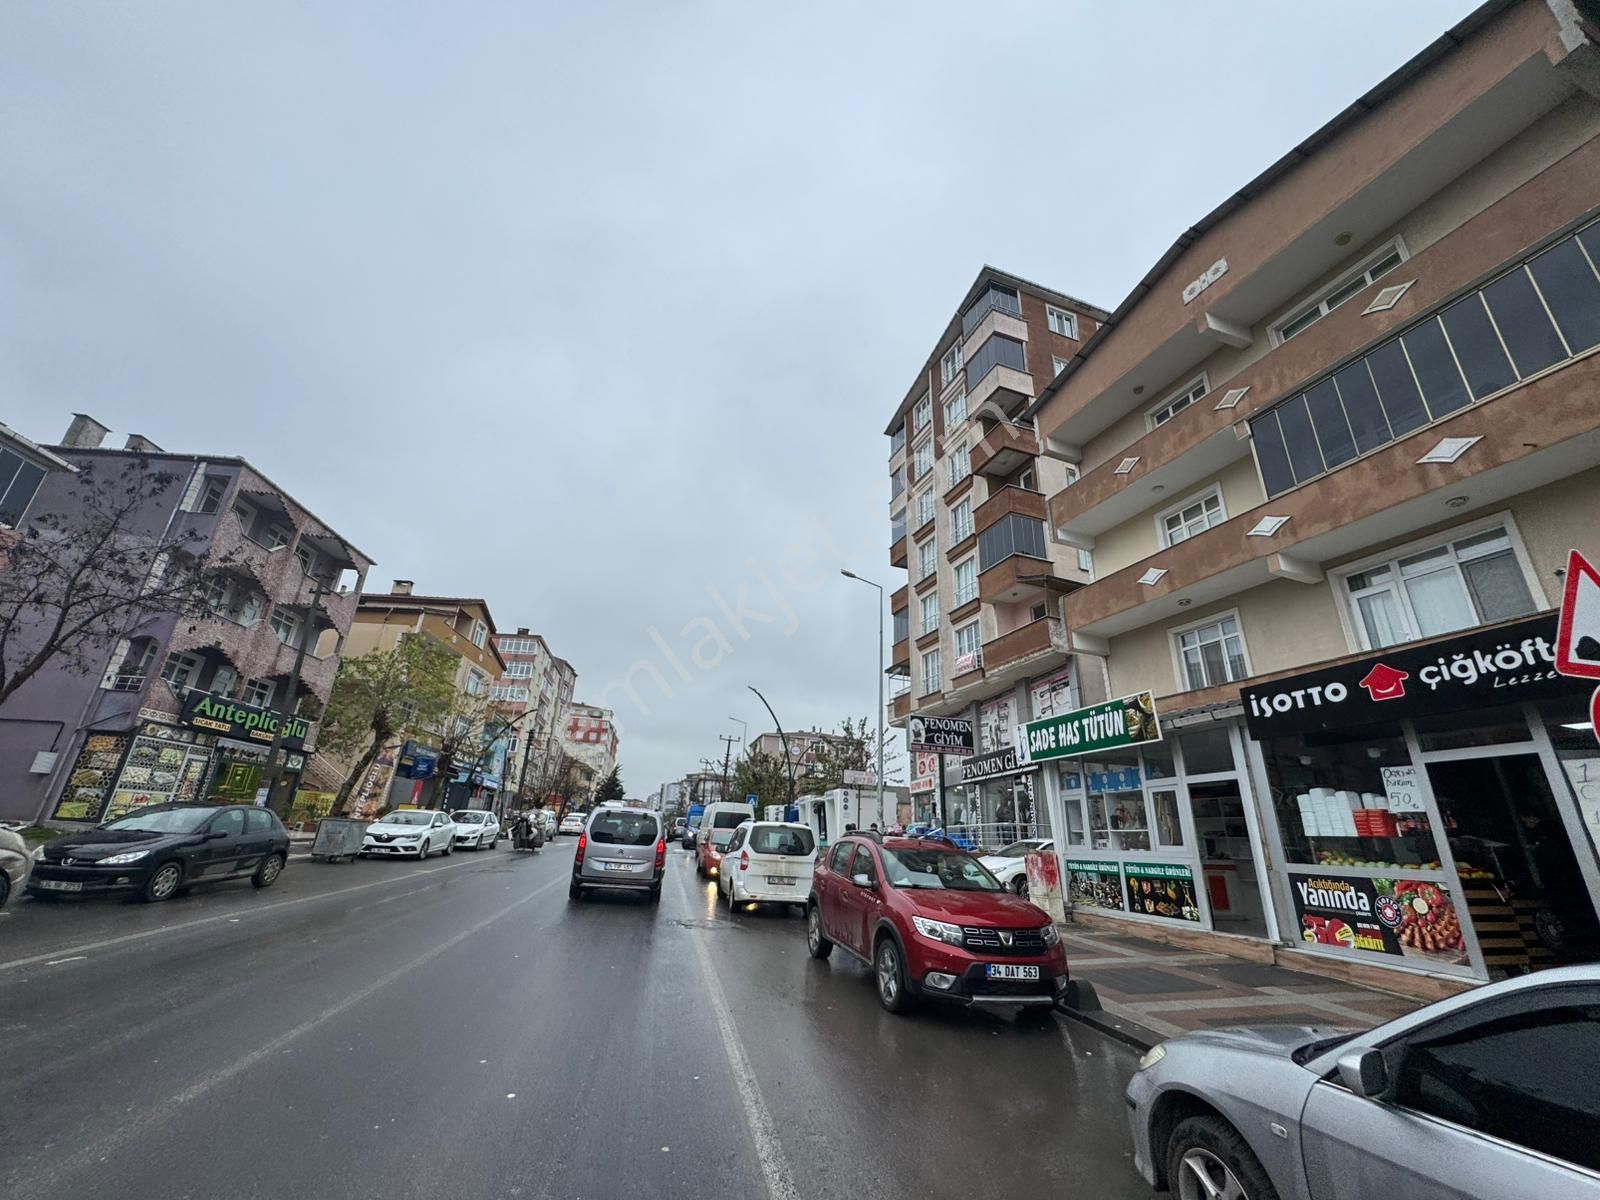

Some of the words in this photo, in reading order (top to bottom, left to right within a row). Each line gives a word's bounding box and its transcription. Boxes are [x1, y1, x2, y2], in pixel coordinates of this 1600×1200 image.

[1419, 636, 1557, 691] çiğköft
[1493, 669, 1558, 689] Lezze
[924, 718, 972, 733] FENOMEN
[1030, 726, 1056, 753] SADE
[1058, 720, 1080, 747] HAS
[1082, 706, 1124, 742] TÜTÜN
[933, 731, 963, 746] GİYİM
[962, 756, 1004, 779] FENOMEN
[1297, 881, 1371, 911] Yanında
[991, 965, 1002, 977] 34
[1005, 966, 1020, 977] DAT
[1023, 966, 1038, 978] 563
